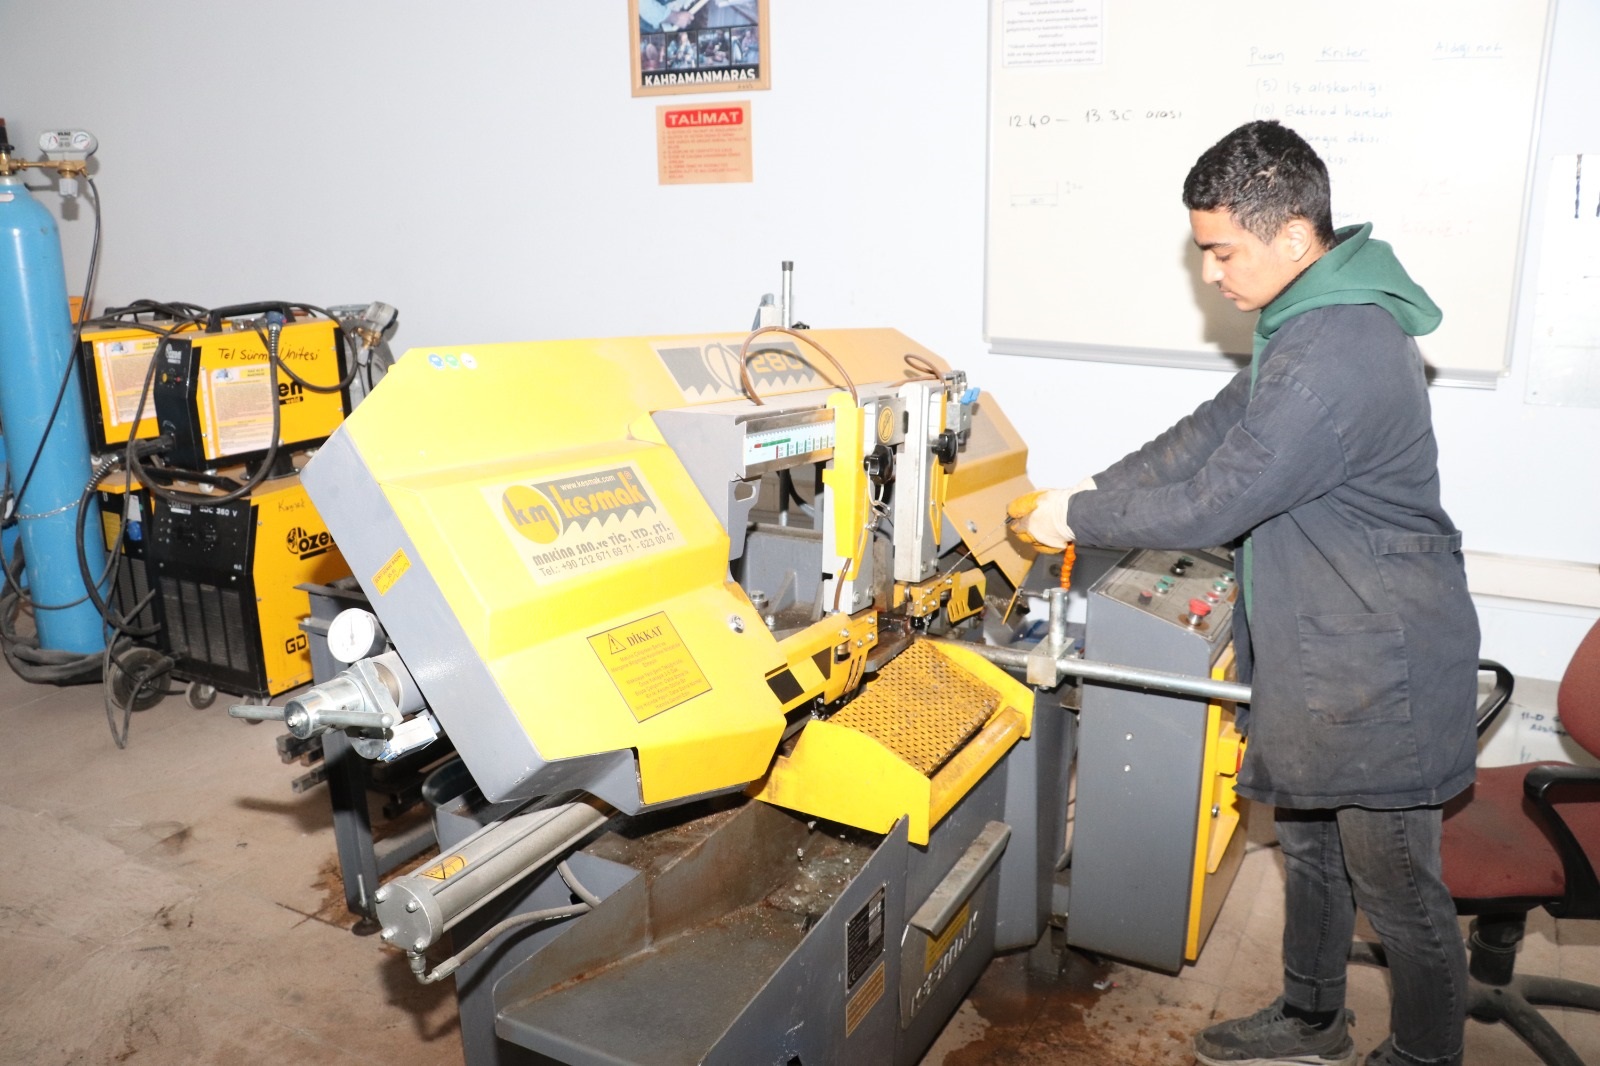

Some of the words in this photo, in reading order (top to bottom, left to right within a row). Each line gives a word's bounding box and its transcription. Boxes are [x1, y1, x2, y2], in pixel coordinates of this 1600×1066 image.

[668, 110, 740, 126] TALİMAT
[1008, 114, 1051, 129] 12.40
[218, 347, 236, 360] Tel
[240, 349, 268, 361] Sürm
[745, 349, 804, 374] 280
[548, 472, 647, 519] kesmak
[532, 545, 576, 566] MAKİNA
[561, 559, 579, 571] +90
[580, 554, 596, 567] 212
[596, 550, 613, 562] 671
[613, 546, 624, 557] 69
[624, 543, 634, 554] 71
[641, 539, 656, 551] 623
[656, 536, 667, 546] 00
[667, 532, 676, 543] 47
[285, 633, 307, 655] GD
[626, 625, 664, 647] DİKKAT
